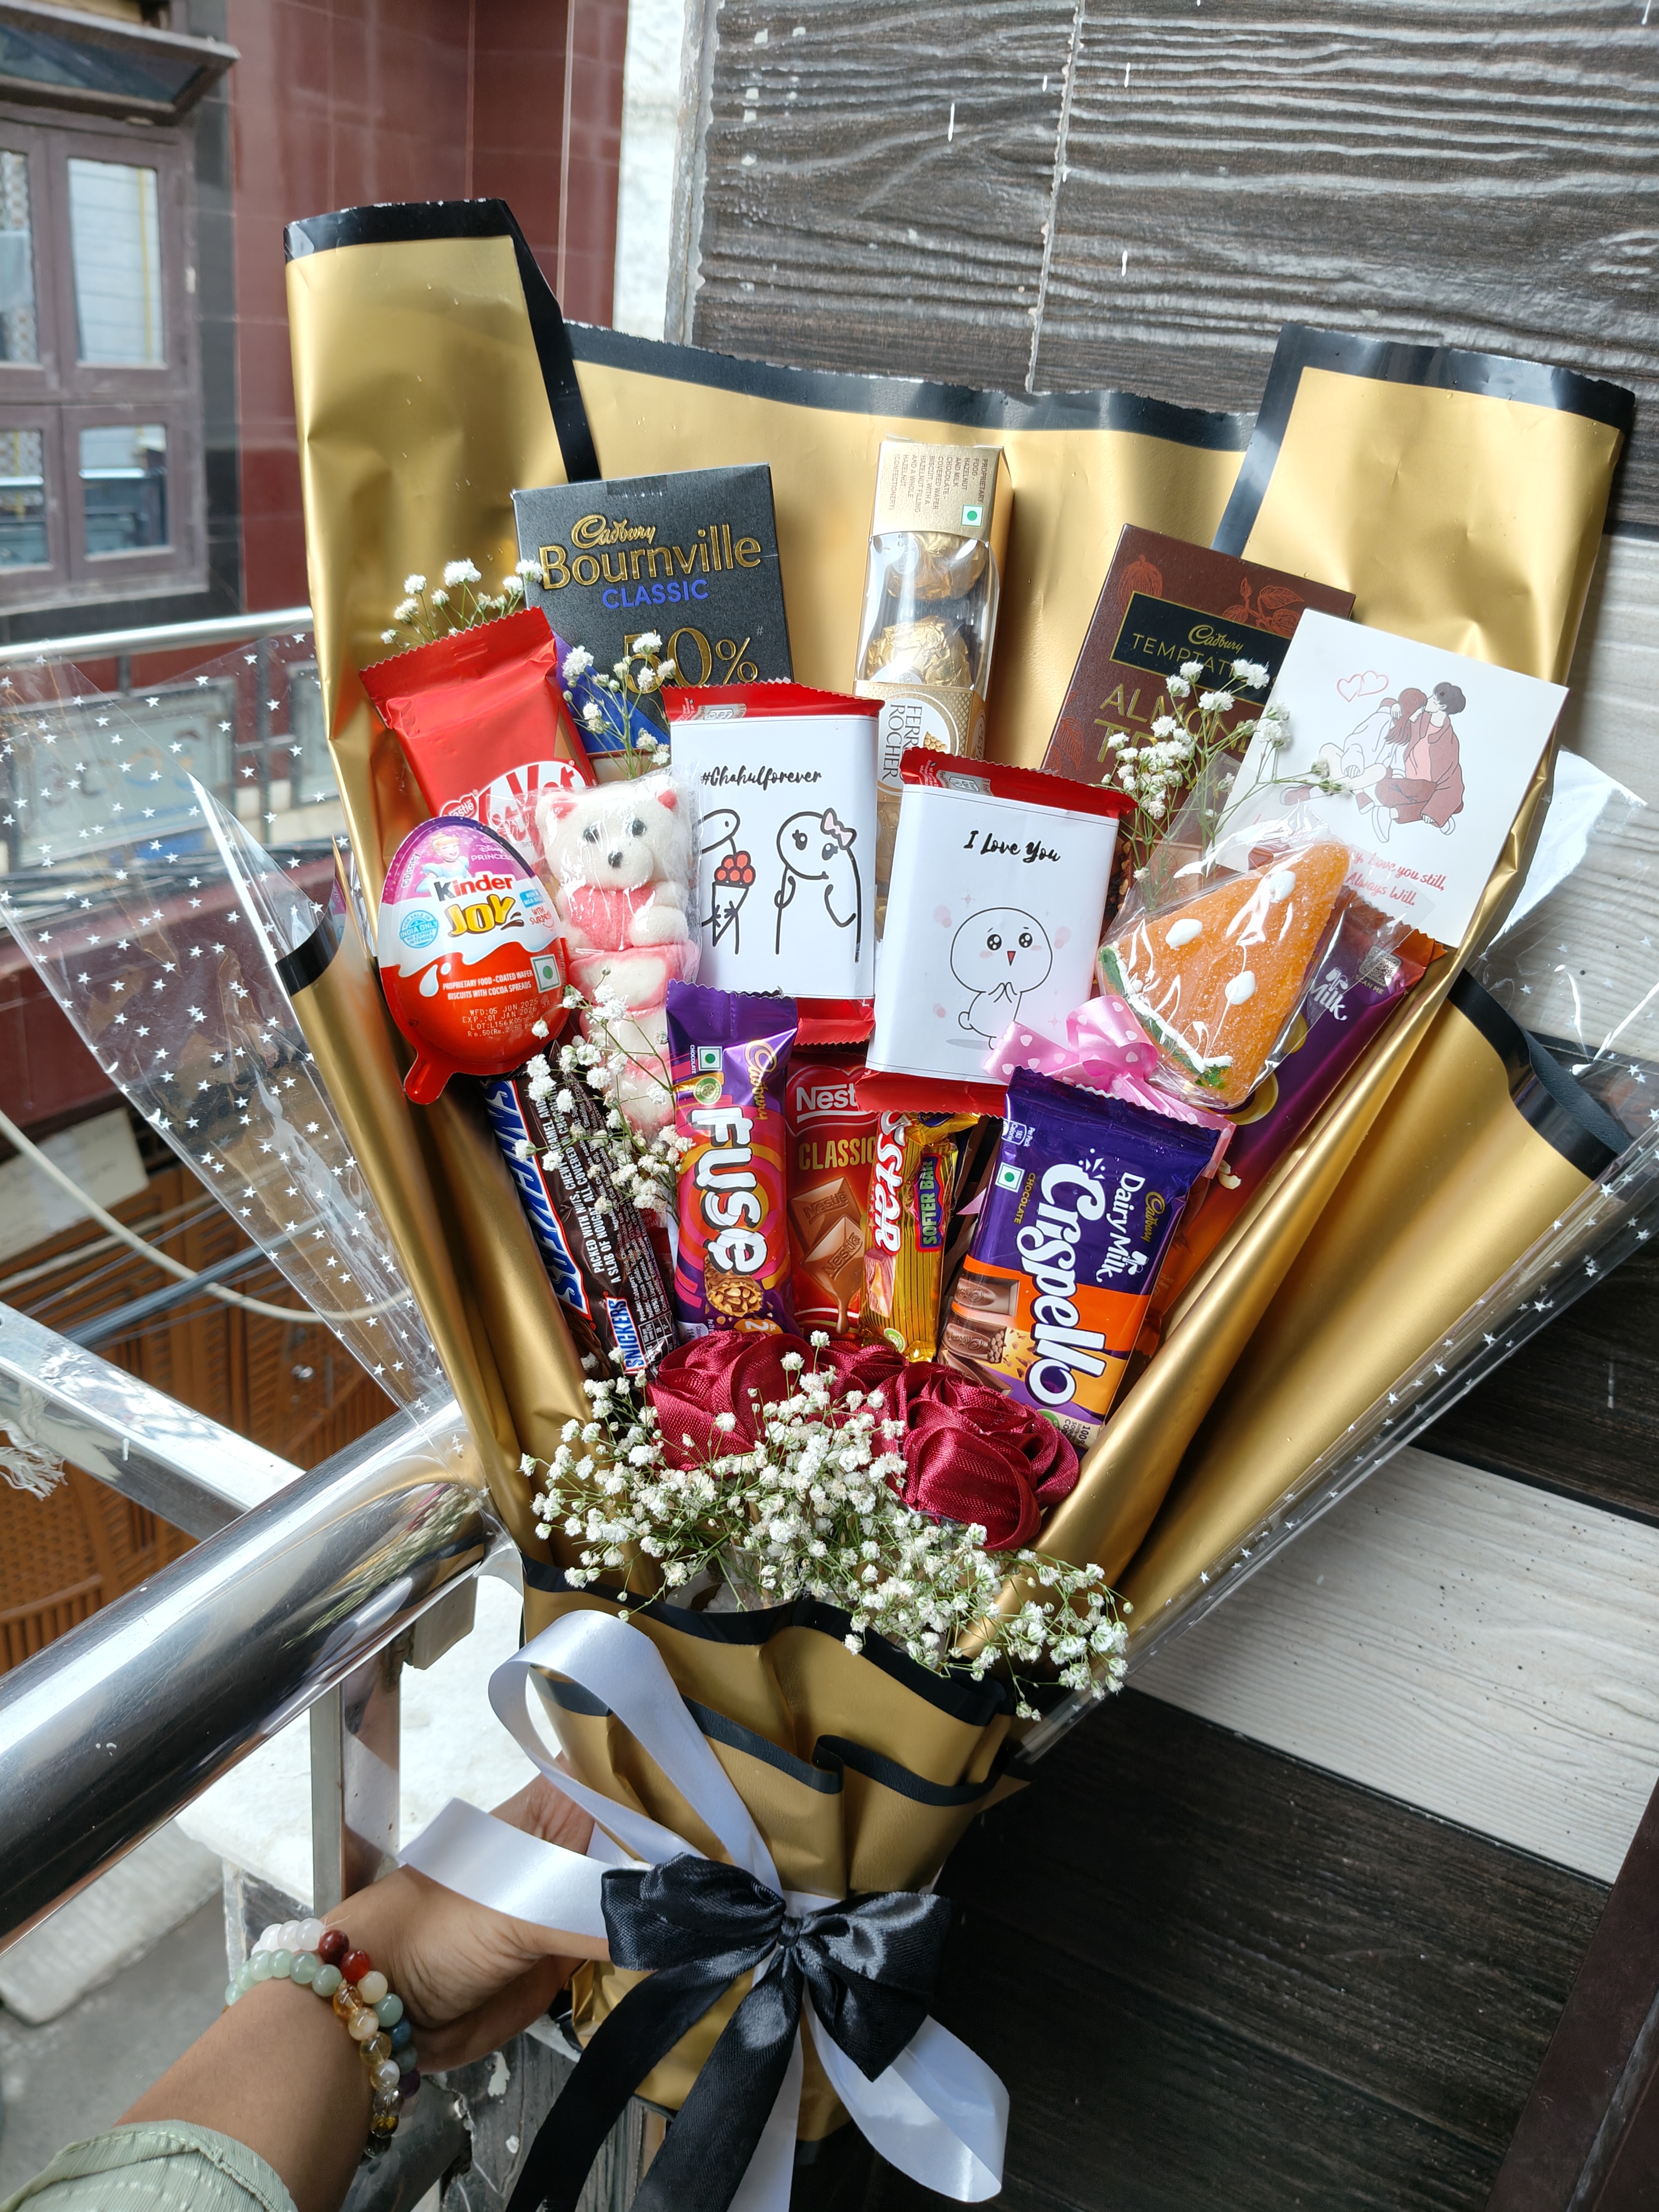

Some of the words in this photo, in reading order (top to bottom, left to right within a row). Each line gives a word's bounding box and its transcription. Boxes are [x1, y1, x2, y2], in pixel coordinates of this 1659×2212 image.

[918, 455, 926, 488] HAZELNUT
[935, 456, 943, 486] COVERED
[943, 457, 953, 495] CHOCOLATE
[961, 457, 970, 491] HAZELNUT
[977, 458, 988, 503] PROPRIETARY
[915, 488, 923, 513] FILLING
[933, 488, 941, 510] WAFER
[571, 514, 656, 549] Cadbury
[538, 524, 761, 590] Bournville
[602, 579, 709, 609] CLASSIC
[1188, 624, 1244, 654] Cadbury
[902, 705, 923, 749] FERR
[882, 704, 906, 781] ROCHER
[471, 854, 515, 862] PRINCESS
[963, 831, 979, 849] I
[980, 833, 1021, 855] Love
[1022, 841, 1061, 863] You
[1345, 872, 1387, 896] Always
[1394, 866, 1419, 879] you
[444, 894, 516, 938] JOY
[400, 927, 419, 938] INDIA
[419, 921, 437, 931] ONLY
[442, 979, 477, 990] PROPRIETARY
[477, 977, 492, 986] FOOD
[516, 970, 533, 979] WAFER
[448, 990, 472, 1000] BISCUITS
[473, 989, 487, 997] WITH
[488, 986, 508, 996] COCOA
[509, 981, 531, 992] SPREADS
[1373, 986, 1384, 995] ME
[501, 1010, 517, 1020] JAN
[520, 1006, 537, 1016] 2026
[502, 1004, 518, 1013] JUN
[520, 997, 538, 1008] 2025
[745, 1040, 777, 1120] Cadbury
[797, 1084, 857, 1111] Nest
[578, 1102, 590, 1127] Emulsifier
[1007, 1122, 1018, 1141] Calorie
[1014, 1129, 1023, 1139] 183
[1023, 1135, 1033, 1148] Pack
[1027, 1127, 1035, 1136] Per
[557, 1161, 576, 1191] CHEWY
[564, 1144, 589, 1186] COVERED
[920, 1161, 935, 1190] BAR
[569, 1190, 586, 1215] NUTS,
[579, 1185, 595, 1203] ALL
[1013, 1172, 1036, 1225] CHOCOLATE
[1106, 1171, 1145, 1234] Dairy
[576, 1213, 594, 1238] WITH
[920, 1192, 938, 1245] SOFTER
[1144, 1191, 1167, 1242] Cadbury
[585, 1237, 605, 1273] PACKED
[597, 1238, 611, 1253] OF
[626, 1249, 637, 1266] Edible
[638, 1236, 651, 1261] vegetable
[1096, 1231, 1135, 1284] Milk
[603, 1252, 619, 1276] SLAB
[623, 1260, 632, 1274] Filled
[632, 1265, 643, 1284] solids,
[639, 1258, 651, 1281] glucose,
[646, 1260, 656, 1277] Edible
[610, 1275, 622, 1283] A
[628, 1273, 641, 1300] Category:
[638, 1283, 649, 1300] Cocoa
[645, 1280, 656, 1297] Liquid
[635, 1299, 646, 1321] Product
[643, 1299, 654, 1318] butter,
[658, 1294, 668, 1311] Cocoa
[609, 1296, 644, 1368] SNICKERS
